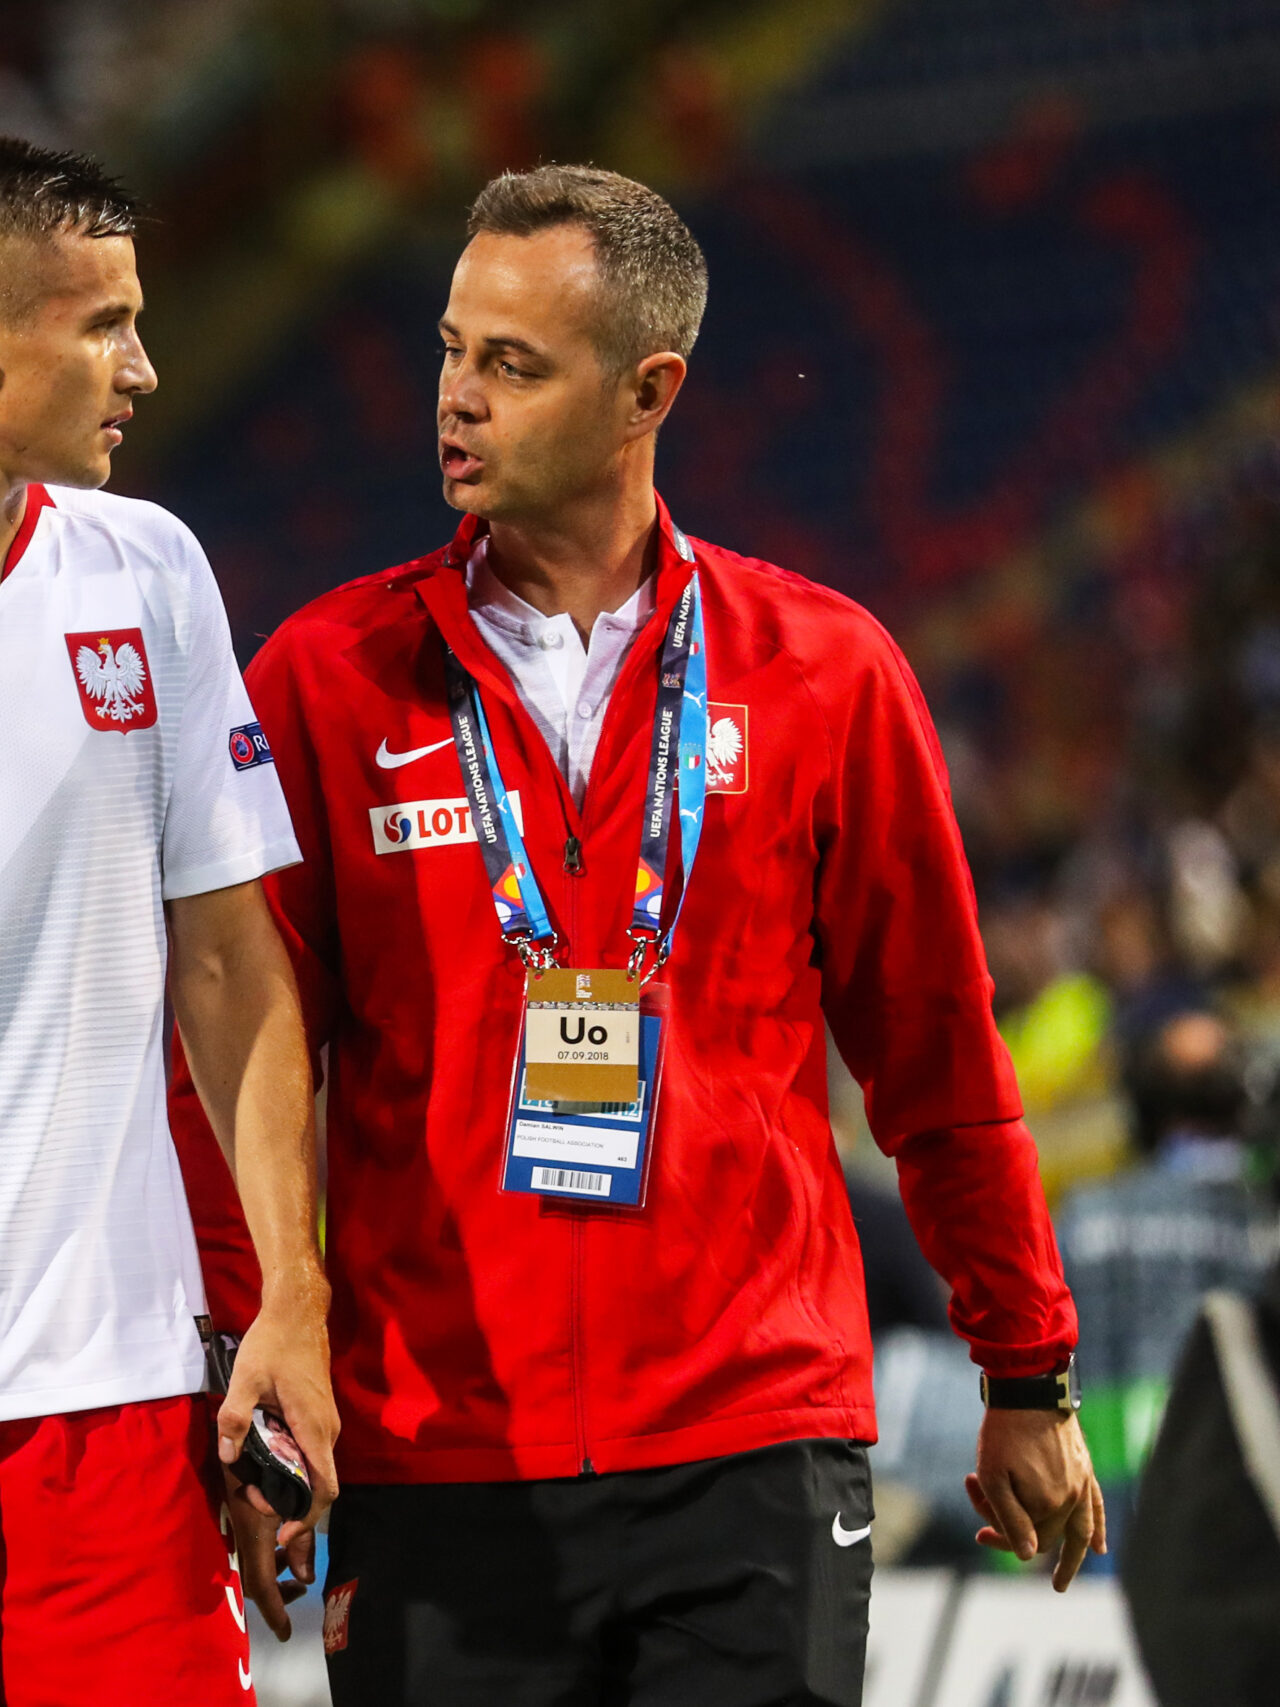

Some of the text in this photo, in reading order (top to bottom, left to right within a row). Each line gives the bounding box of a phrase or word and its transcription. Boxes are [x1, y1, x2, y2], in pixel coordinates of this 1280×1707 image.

[679, 584, 691, 621] NATIO
[672, 622, 687, 648] UEFA
[459, 715, 498, 844] UEFA NATIONS LEAGUE
[650, 709, 673, 838] UEFA NATIONS LEAGUE
[417, 806, 476, 839] LOT
[560, 1016, 608, 1046] Uo
[557, 1051, 609, 1061] 07.09.2018
[538, 1136, 566, 1145] FOOTBALL
